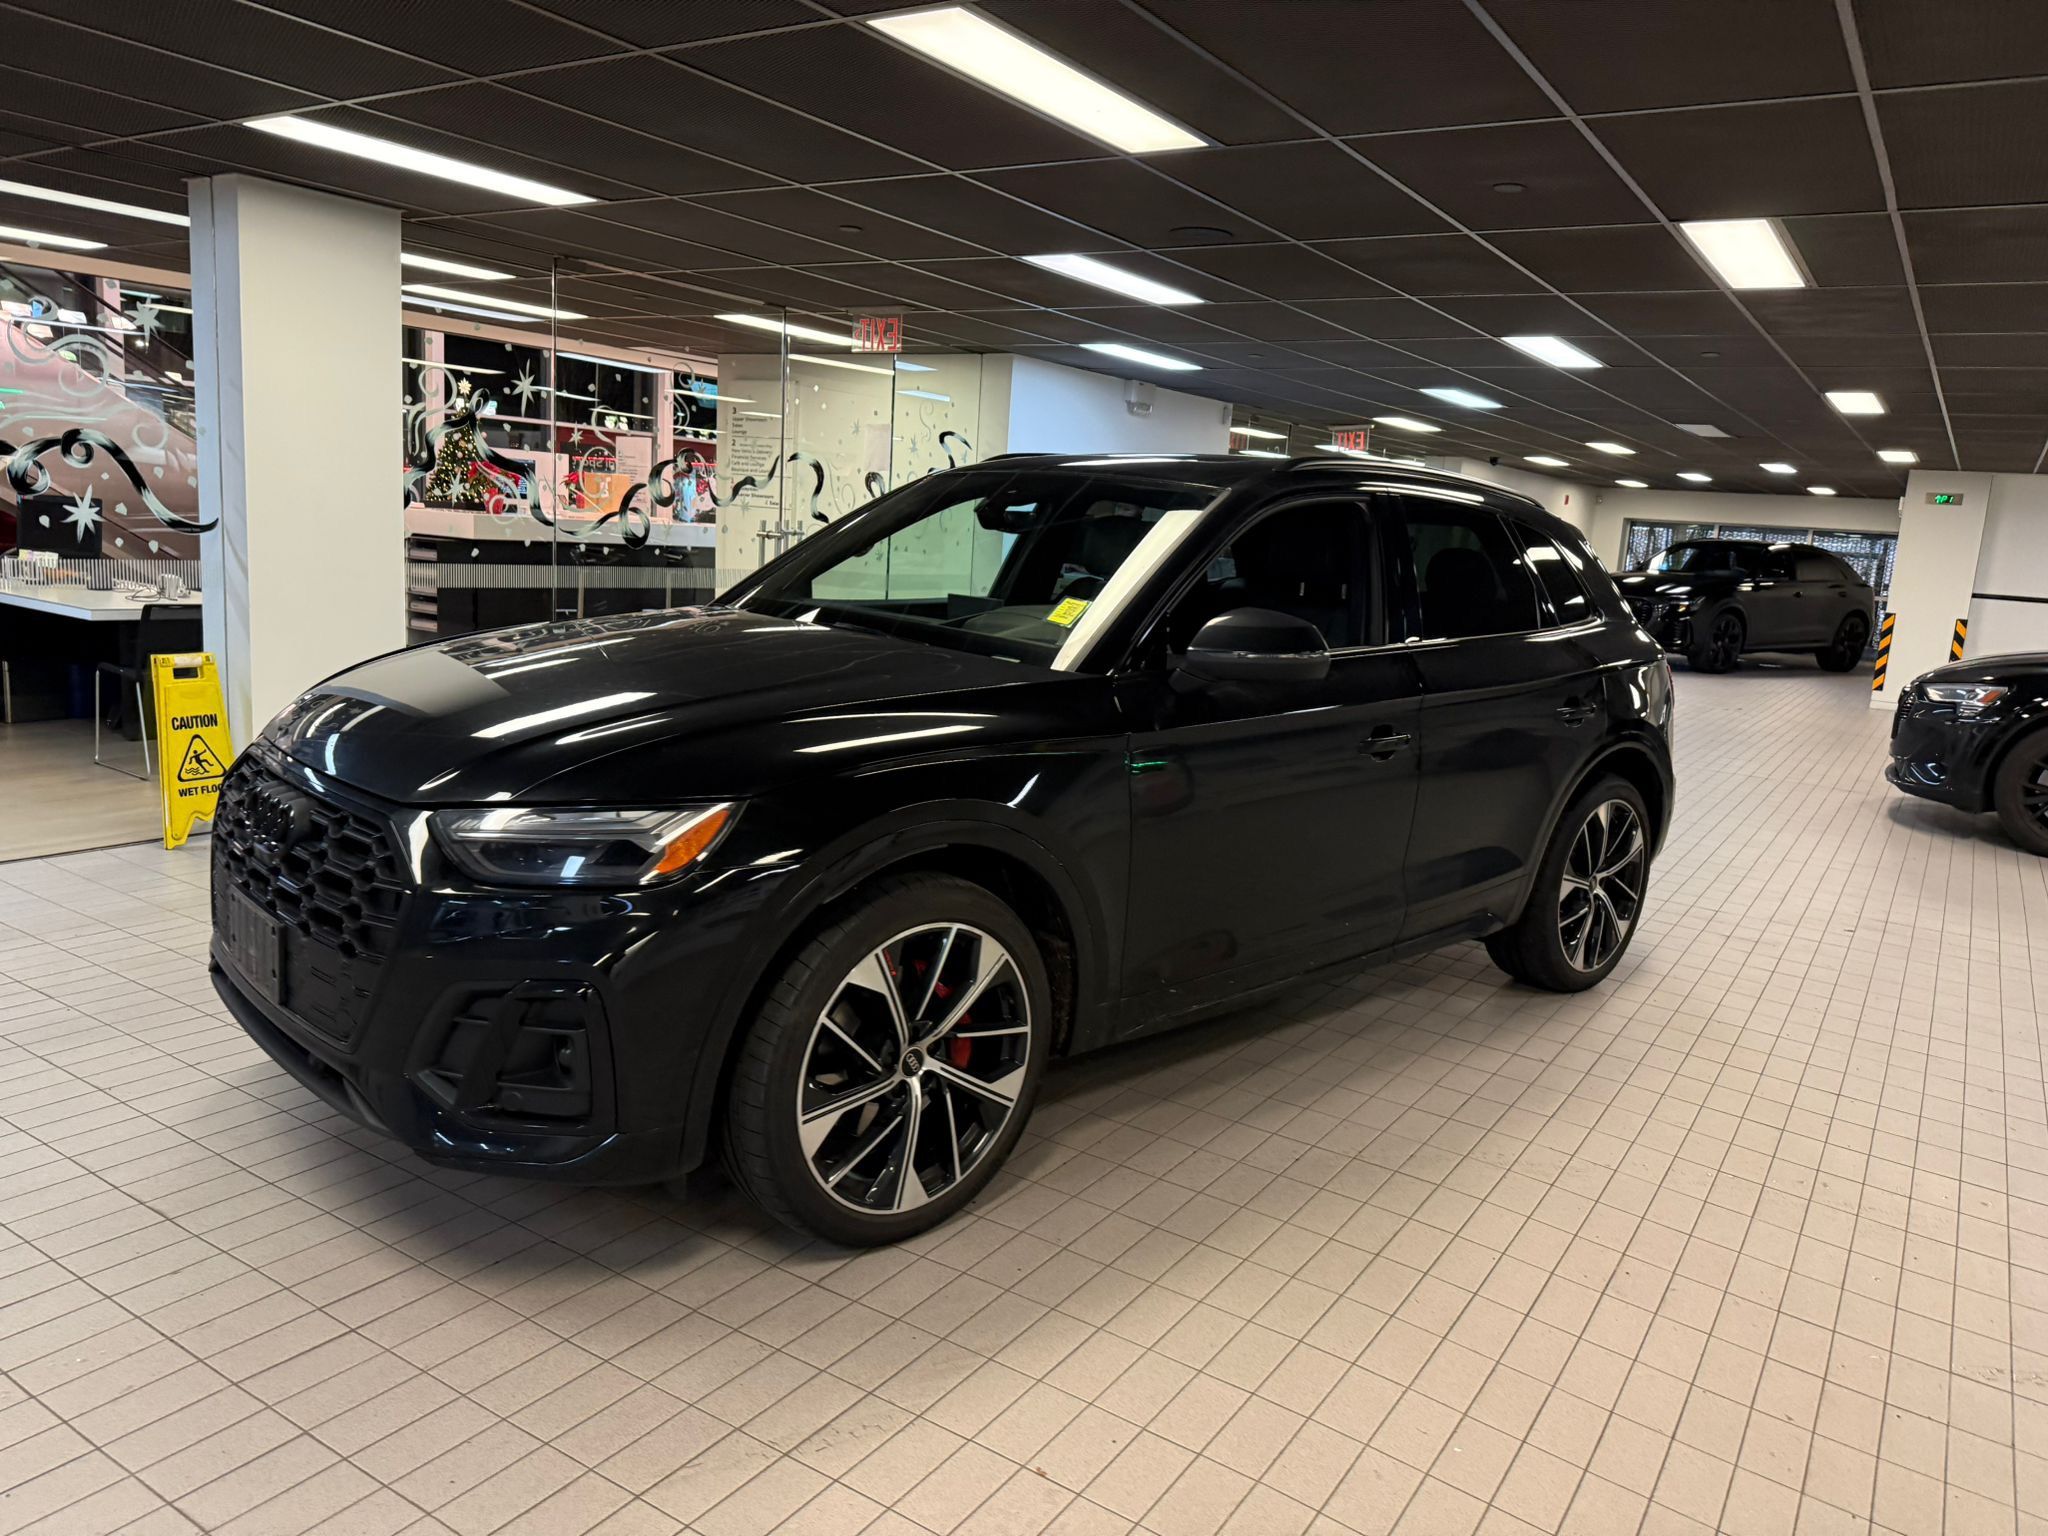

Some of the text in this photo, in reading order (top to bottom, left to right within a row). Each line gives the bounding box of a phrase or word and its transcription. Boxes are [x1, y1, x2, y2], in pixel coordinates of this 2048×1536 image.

[732, 406, 737, 414] 3
[171, 713, 218, 731] CAUTION
[178, 786, 199, 798] WET
